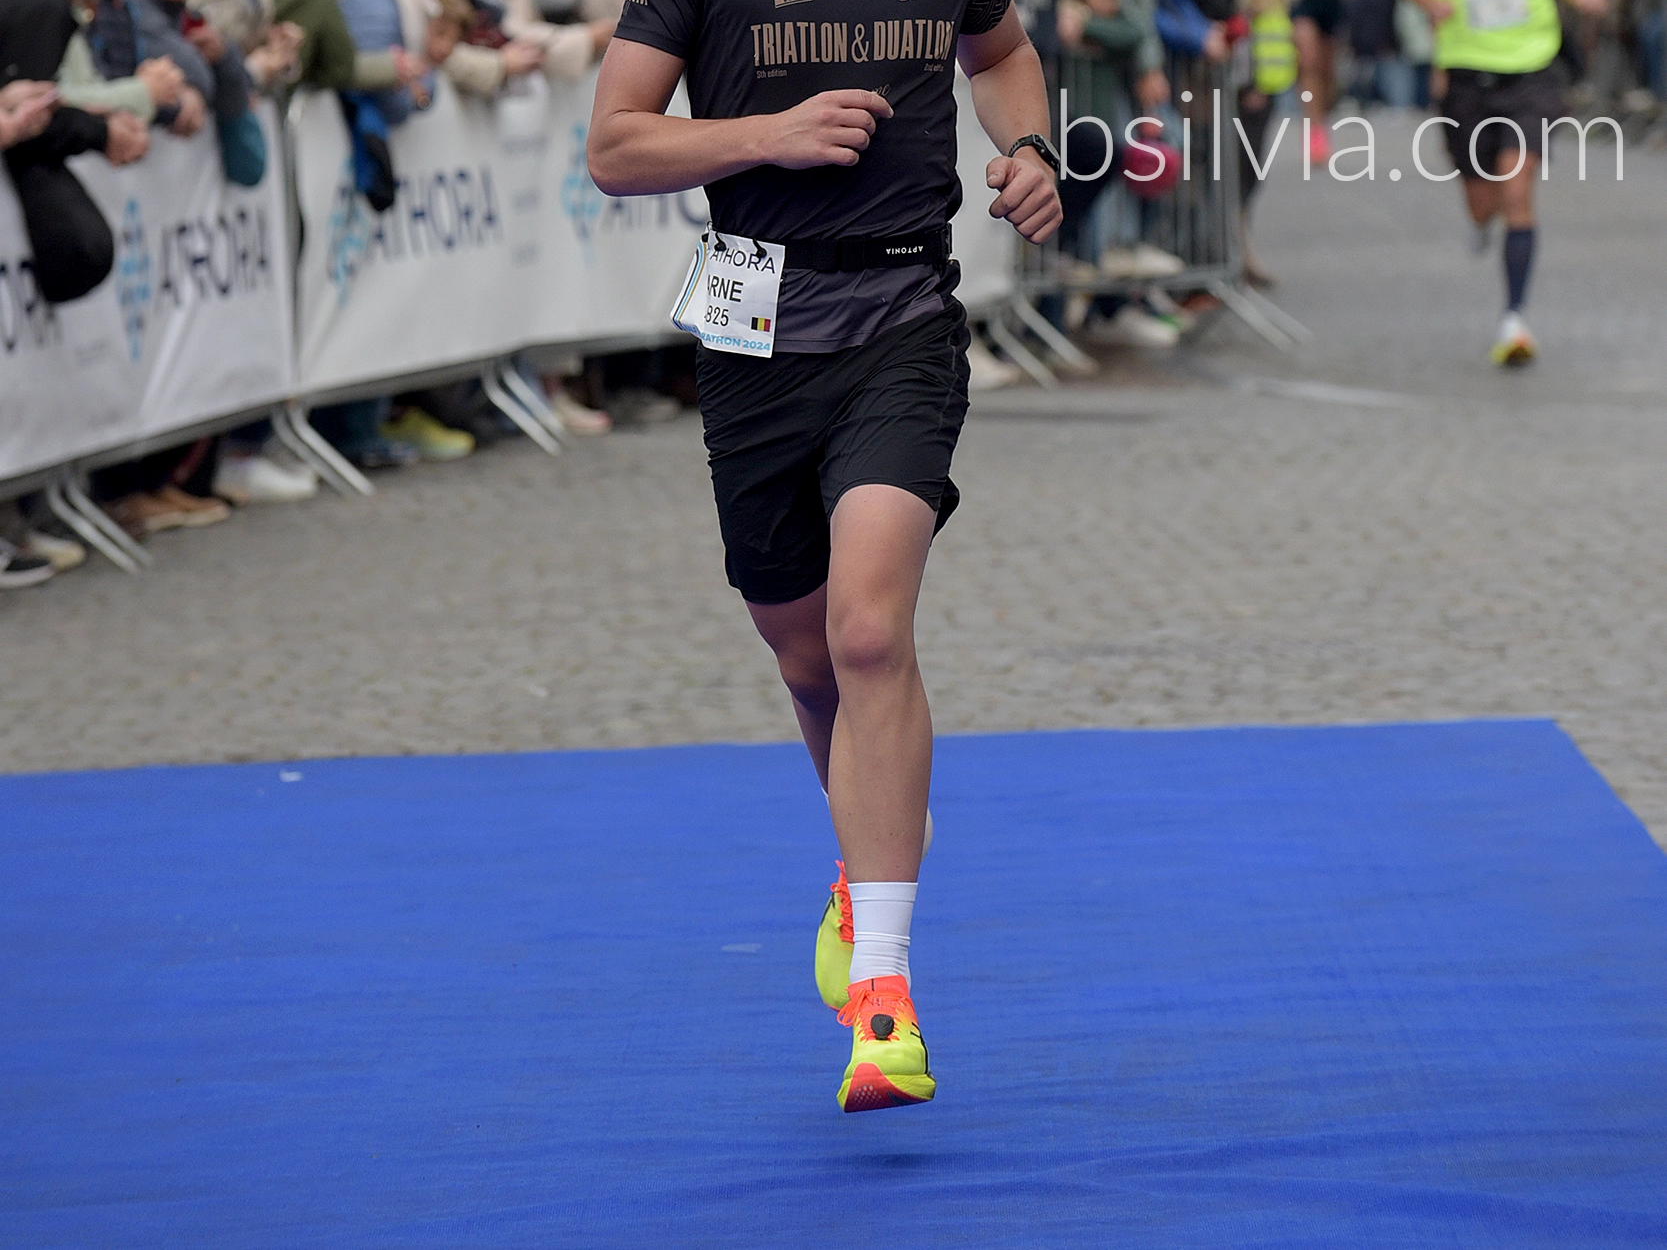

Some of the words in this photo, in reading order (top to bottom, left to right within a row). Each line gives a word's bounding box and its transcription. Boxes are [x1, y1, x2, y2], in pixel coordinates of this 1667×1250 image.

[750, 21, 848, 67] TRIATLON
[851, 23, 870, 64] &
[873, 19, 955, 61] DUATLON
[767, 68, 788, 78] edition
[886, 245, 924, 255] APTONIA
[709, 247, 776, 275] ATHORA
[704, 305, 729, 327] 825
[742, 339, 771, 352] 2024
